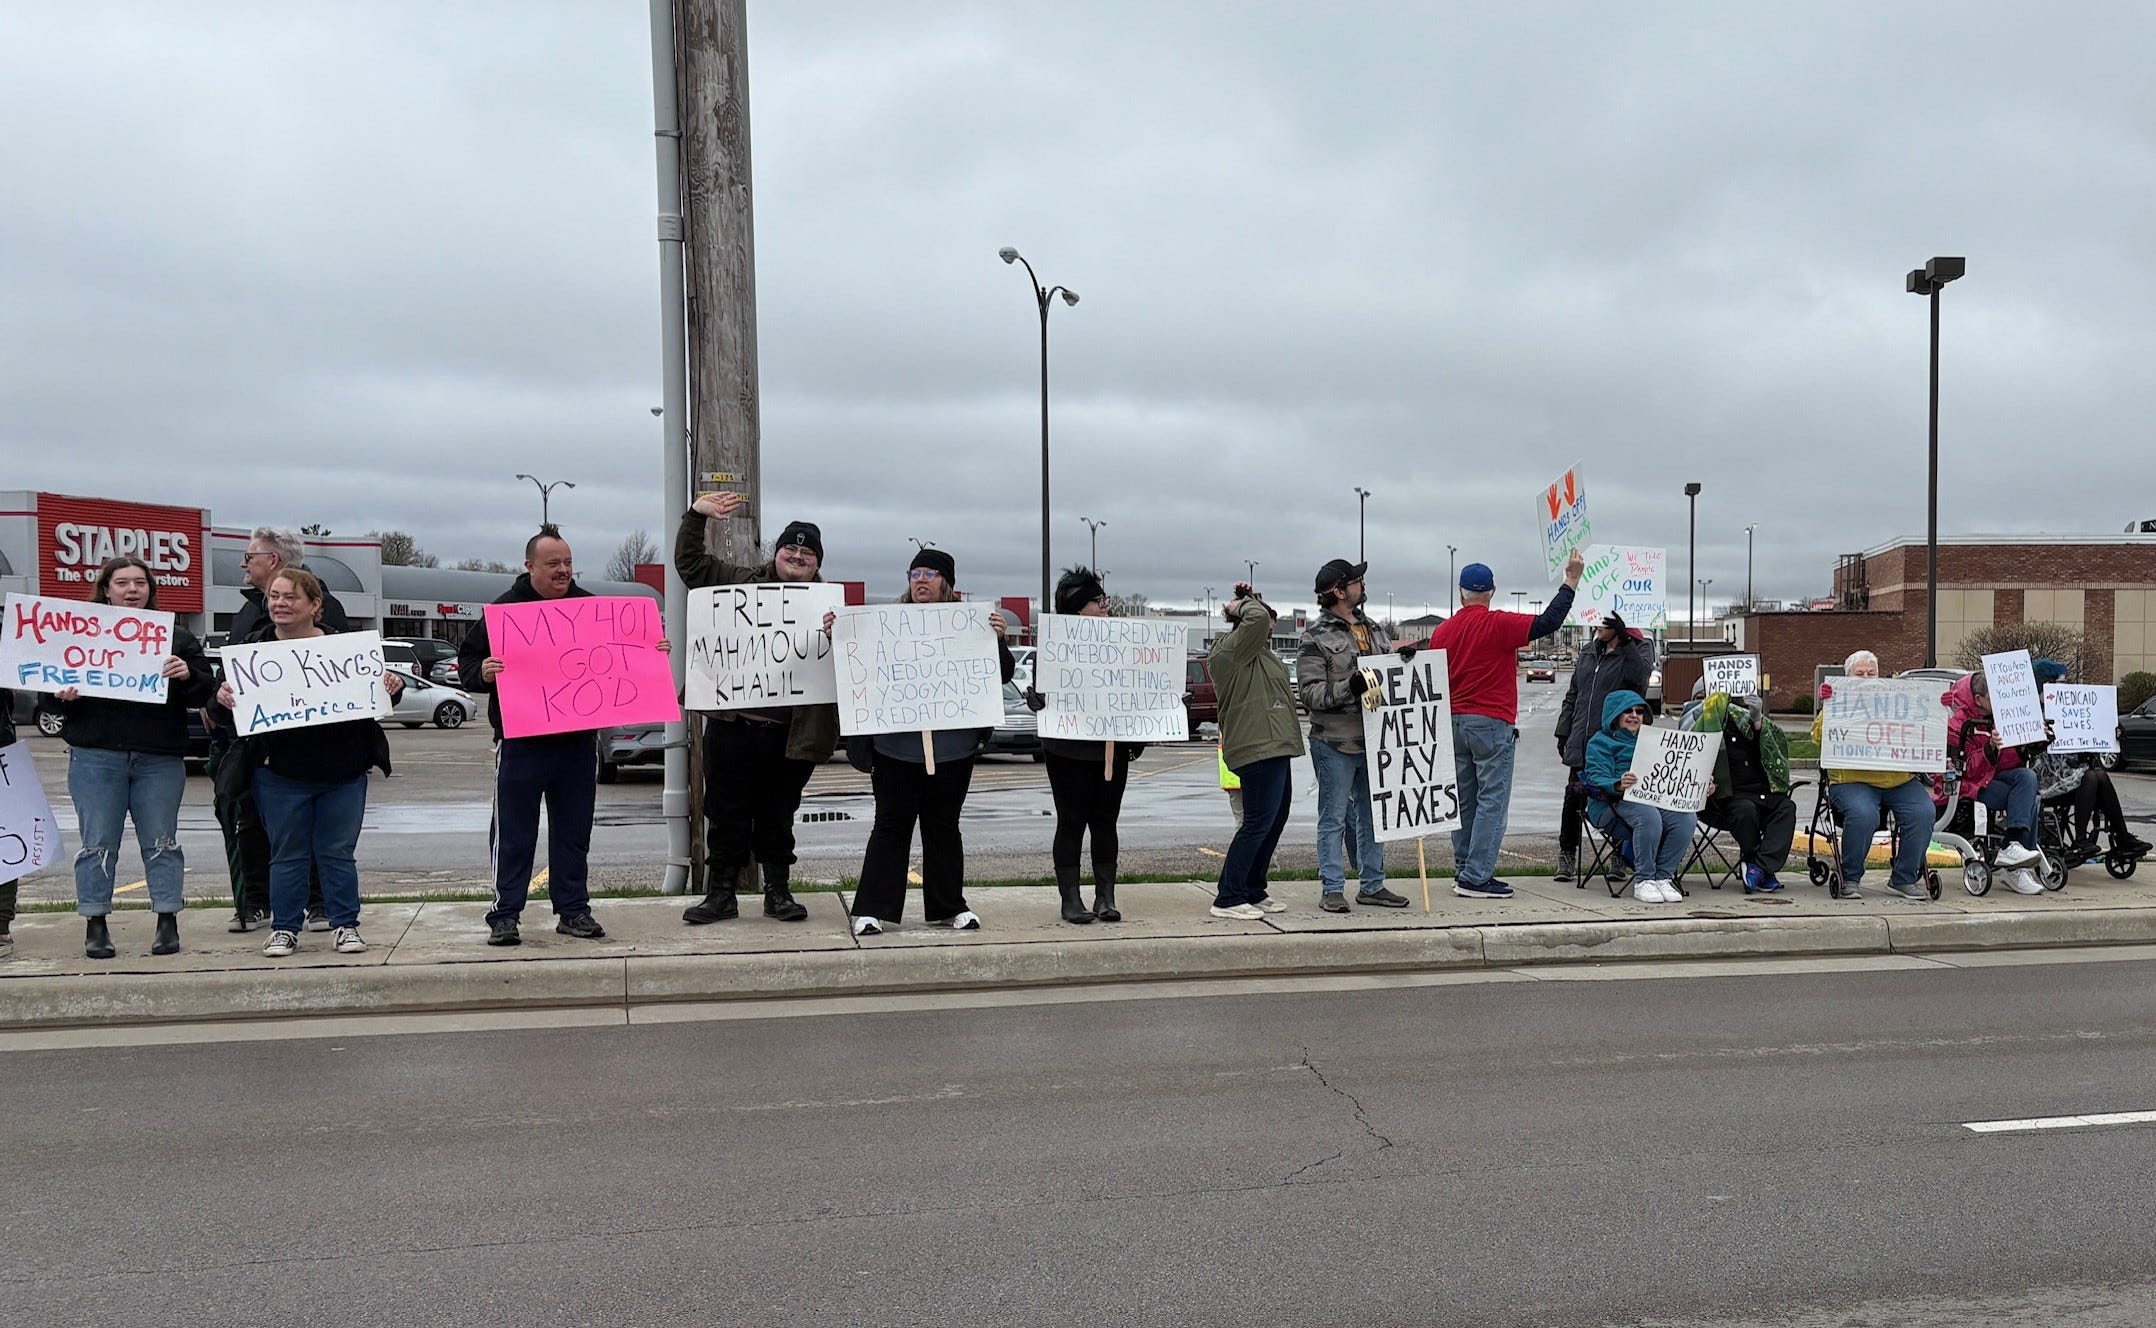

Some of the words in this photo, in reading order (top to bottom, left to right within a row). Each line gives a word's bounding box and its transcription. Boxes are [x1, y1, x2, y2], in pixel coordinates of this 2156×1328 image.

[1547, 512, 1570, 545] HANDS
[55, 522, 191, 572] STAPLES
[55, 567, 81, 582] The
[1592, 568, 1619, 601] OFF
[1622, 579, 1652, 591] OUR
[712, 585, 810, 628] FREE
[502, 603, 585, 655] MY
[595, 602, 646, 640] 401
[1064, 618, 1151, 644] WONDERED
[1154, 623, 1187, 645] WHY
[690, 629, 832, 670] MAHMOUD
[1044, 641, 1127, 664] SOMEBODY
[1132, 647, 1175, 665] DIDN'T
[559, 642, 645, 680] GOT
[1708, 660, 1752, 670] HANDS
[18, 662, 165, 697] FREEDOM!
[1060, 668, 1083, 689] DO
[1717, 670, 1741, 679] OFF
[1997, 672, 2025, 685] ANGRY
[716, 670, 804, 706] KHALIL
[1709, 680, 1756, 695] MEDICAID
[1996, 688, 2010, 700] You
[2055, 690, 2097, 706] MEDICAID
[290, 693, 308, 708] in
[1046, 692, 1085, 712] THEN
[1108, 692, 1180, 712] REALIZED
[1829, 692, 1930, 721] HANDS
[855, 699, 978, 731] PREDATOR
[2000, 705, 2031, 720] PAYING
[2061, 707, 2091, 718] SAVES
[1057, 714, 1079, 735] AM
[1380, 705, 1438, 750] MEN
[1828, 728, 1848, 741] MY
[2002, 720, 2042, 737] ATTENTION
[1660, 731, 1706, 752] HANDS
[1833, 744, 1881, 756] MONEY
[1377, 743, 1437, 788] PAY
[1665, 750, 1693, 768] OFF
[1651, 763, 1699, 783] SOCIAL
[1373, 784, 1458, 830] TAXES
[1629, 788, 1662, 803] MEDICARE
[1670, 798, 1701, 810] MEDICAID
